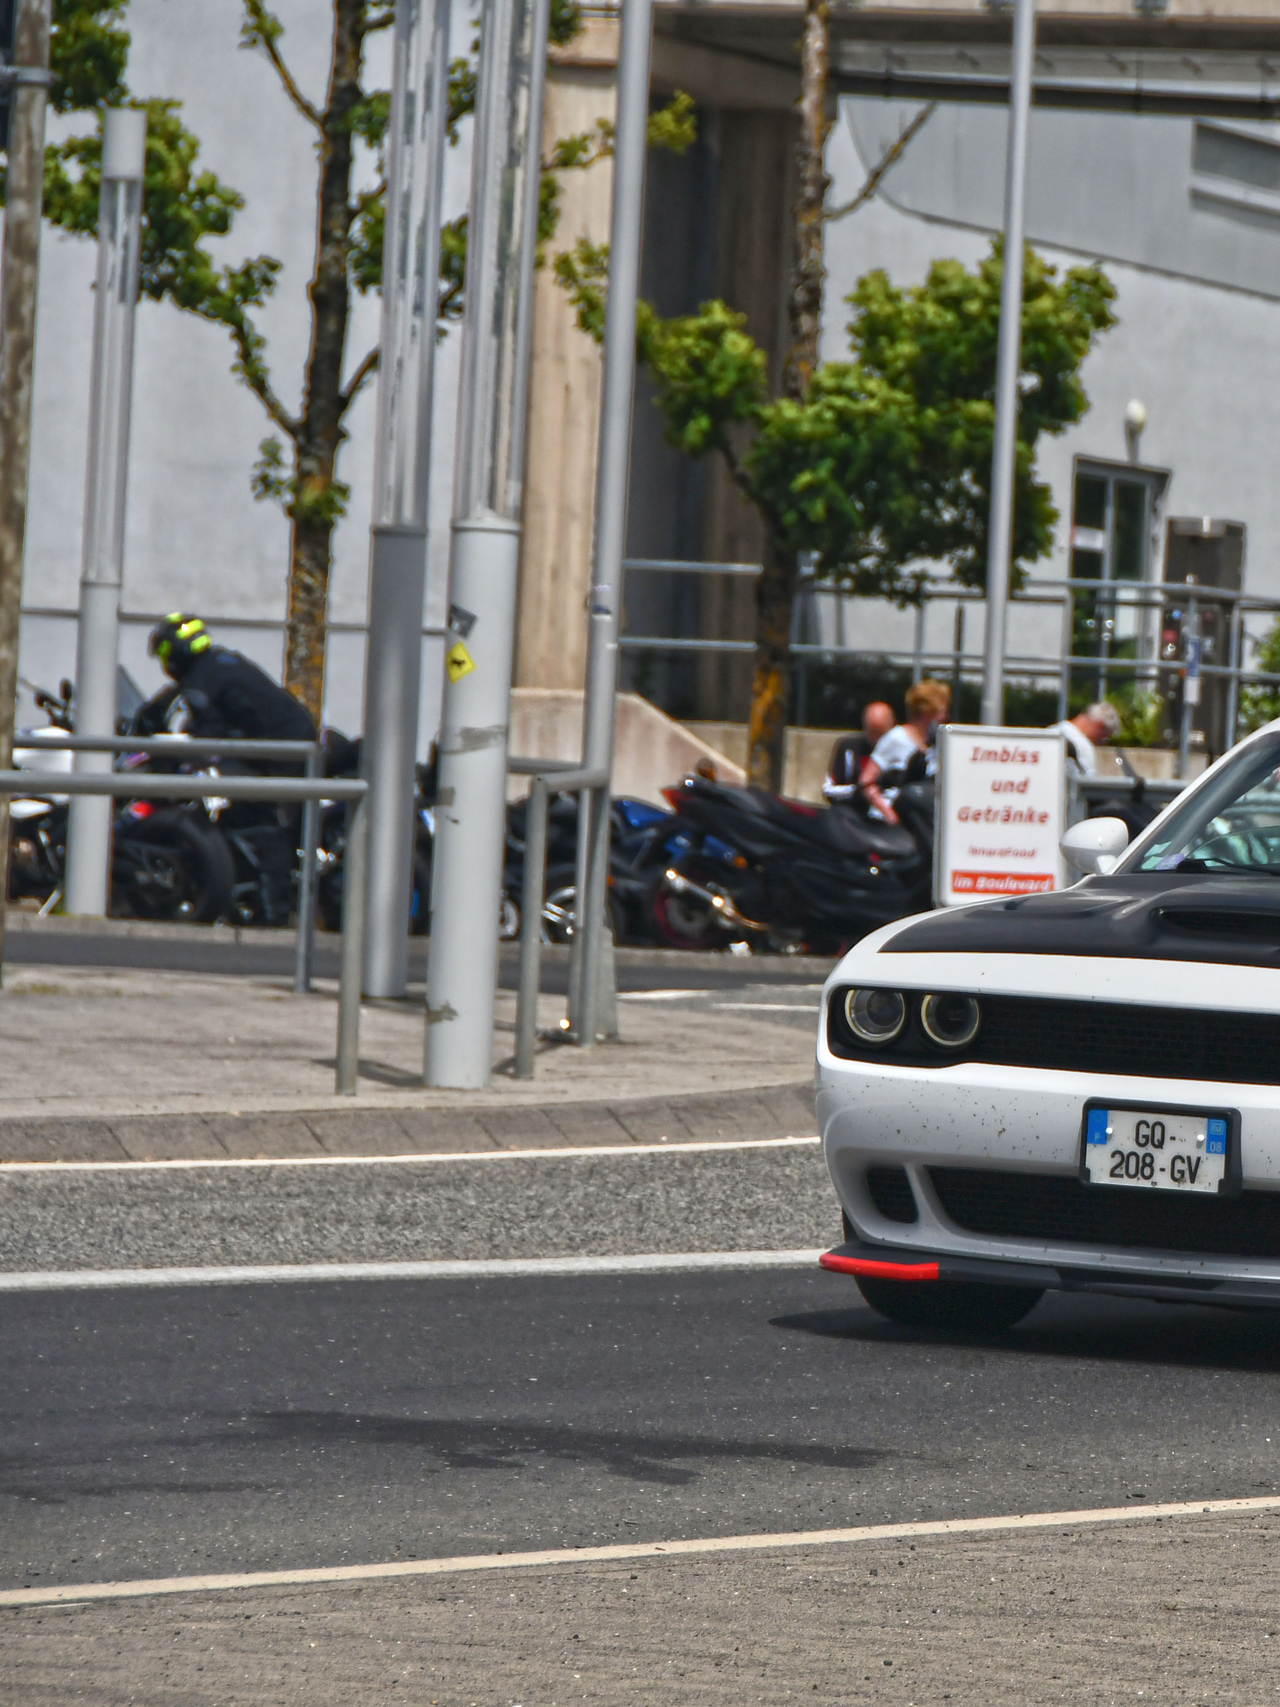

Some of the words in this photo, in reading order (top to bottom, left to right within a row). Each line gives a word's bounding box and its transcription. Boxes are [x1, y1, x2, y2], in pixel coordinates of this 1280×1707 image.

[971, 745, 1041, 764] Imbiss
[991, 777, 1030, 794] und
[957, 805, 1050, 825] Getränke
[954, 874, 973, 889] im
[975, 875, 1052, 892] Boulevard
[1209, 1141, 1222, 1153] 08
[1109, 1150, 1202, 1184] 208-GV
